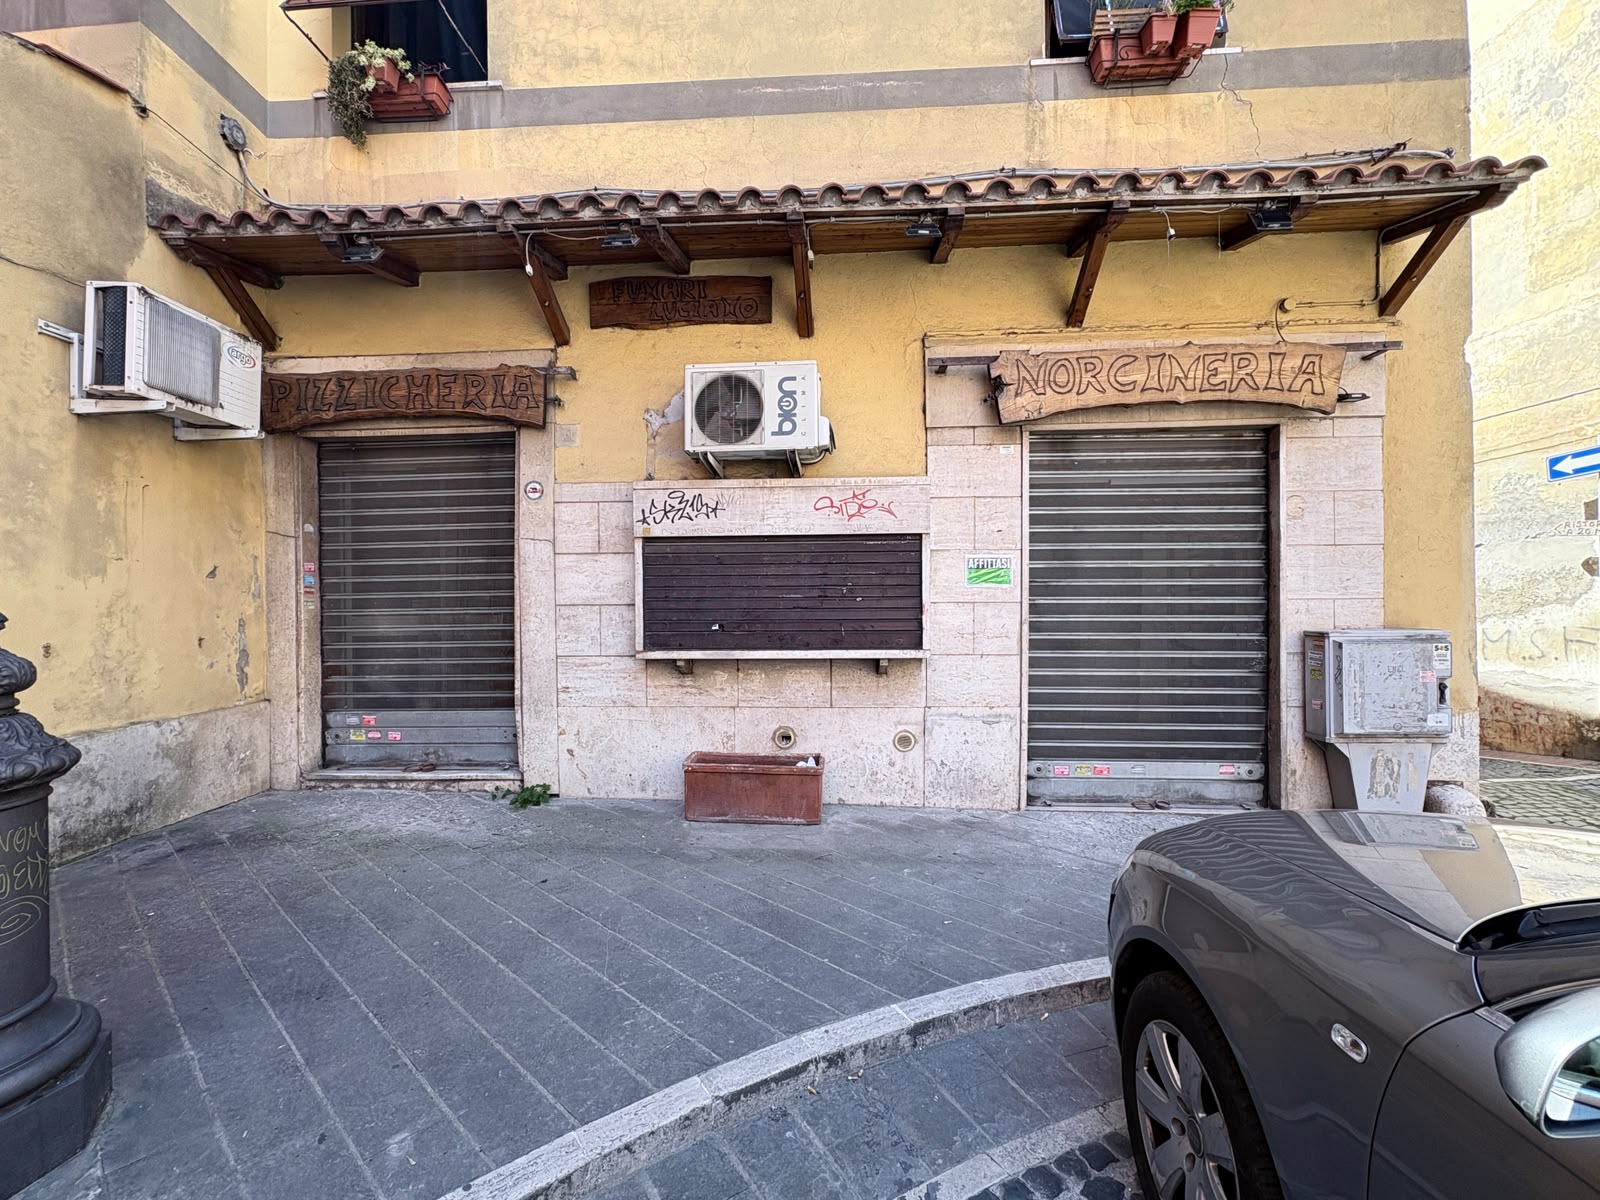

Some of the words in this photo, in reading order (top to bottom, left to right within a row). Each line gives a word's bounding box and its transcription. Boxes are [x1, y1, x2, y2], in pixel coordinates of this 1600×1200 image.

[648, 296, 759, 322] LUCIANO
[230, 348, 252, 366] argo
[1015, 351, 1326, 397] NORCINERIA
[268, 374, 540, 413] PIZZICHERIA
[968, 558, 1010, 569] AFFITTASI
